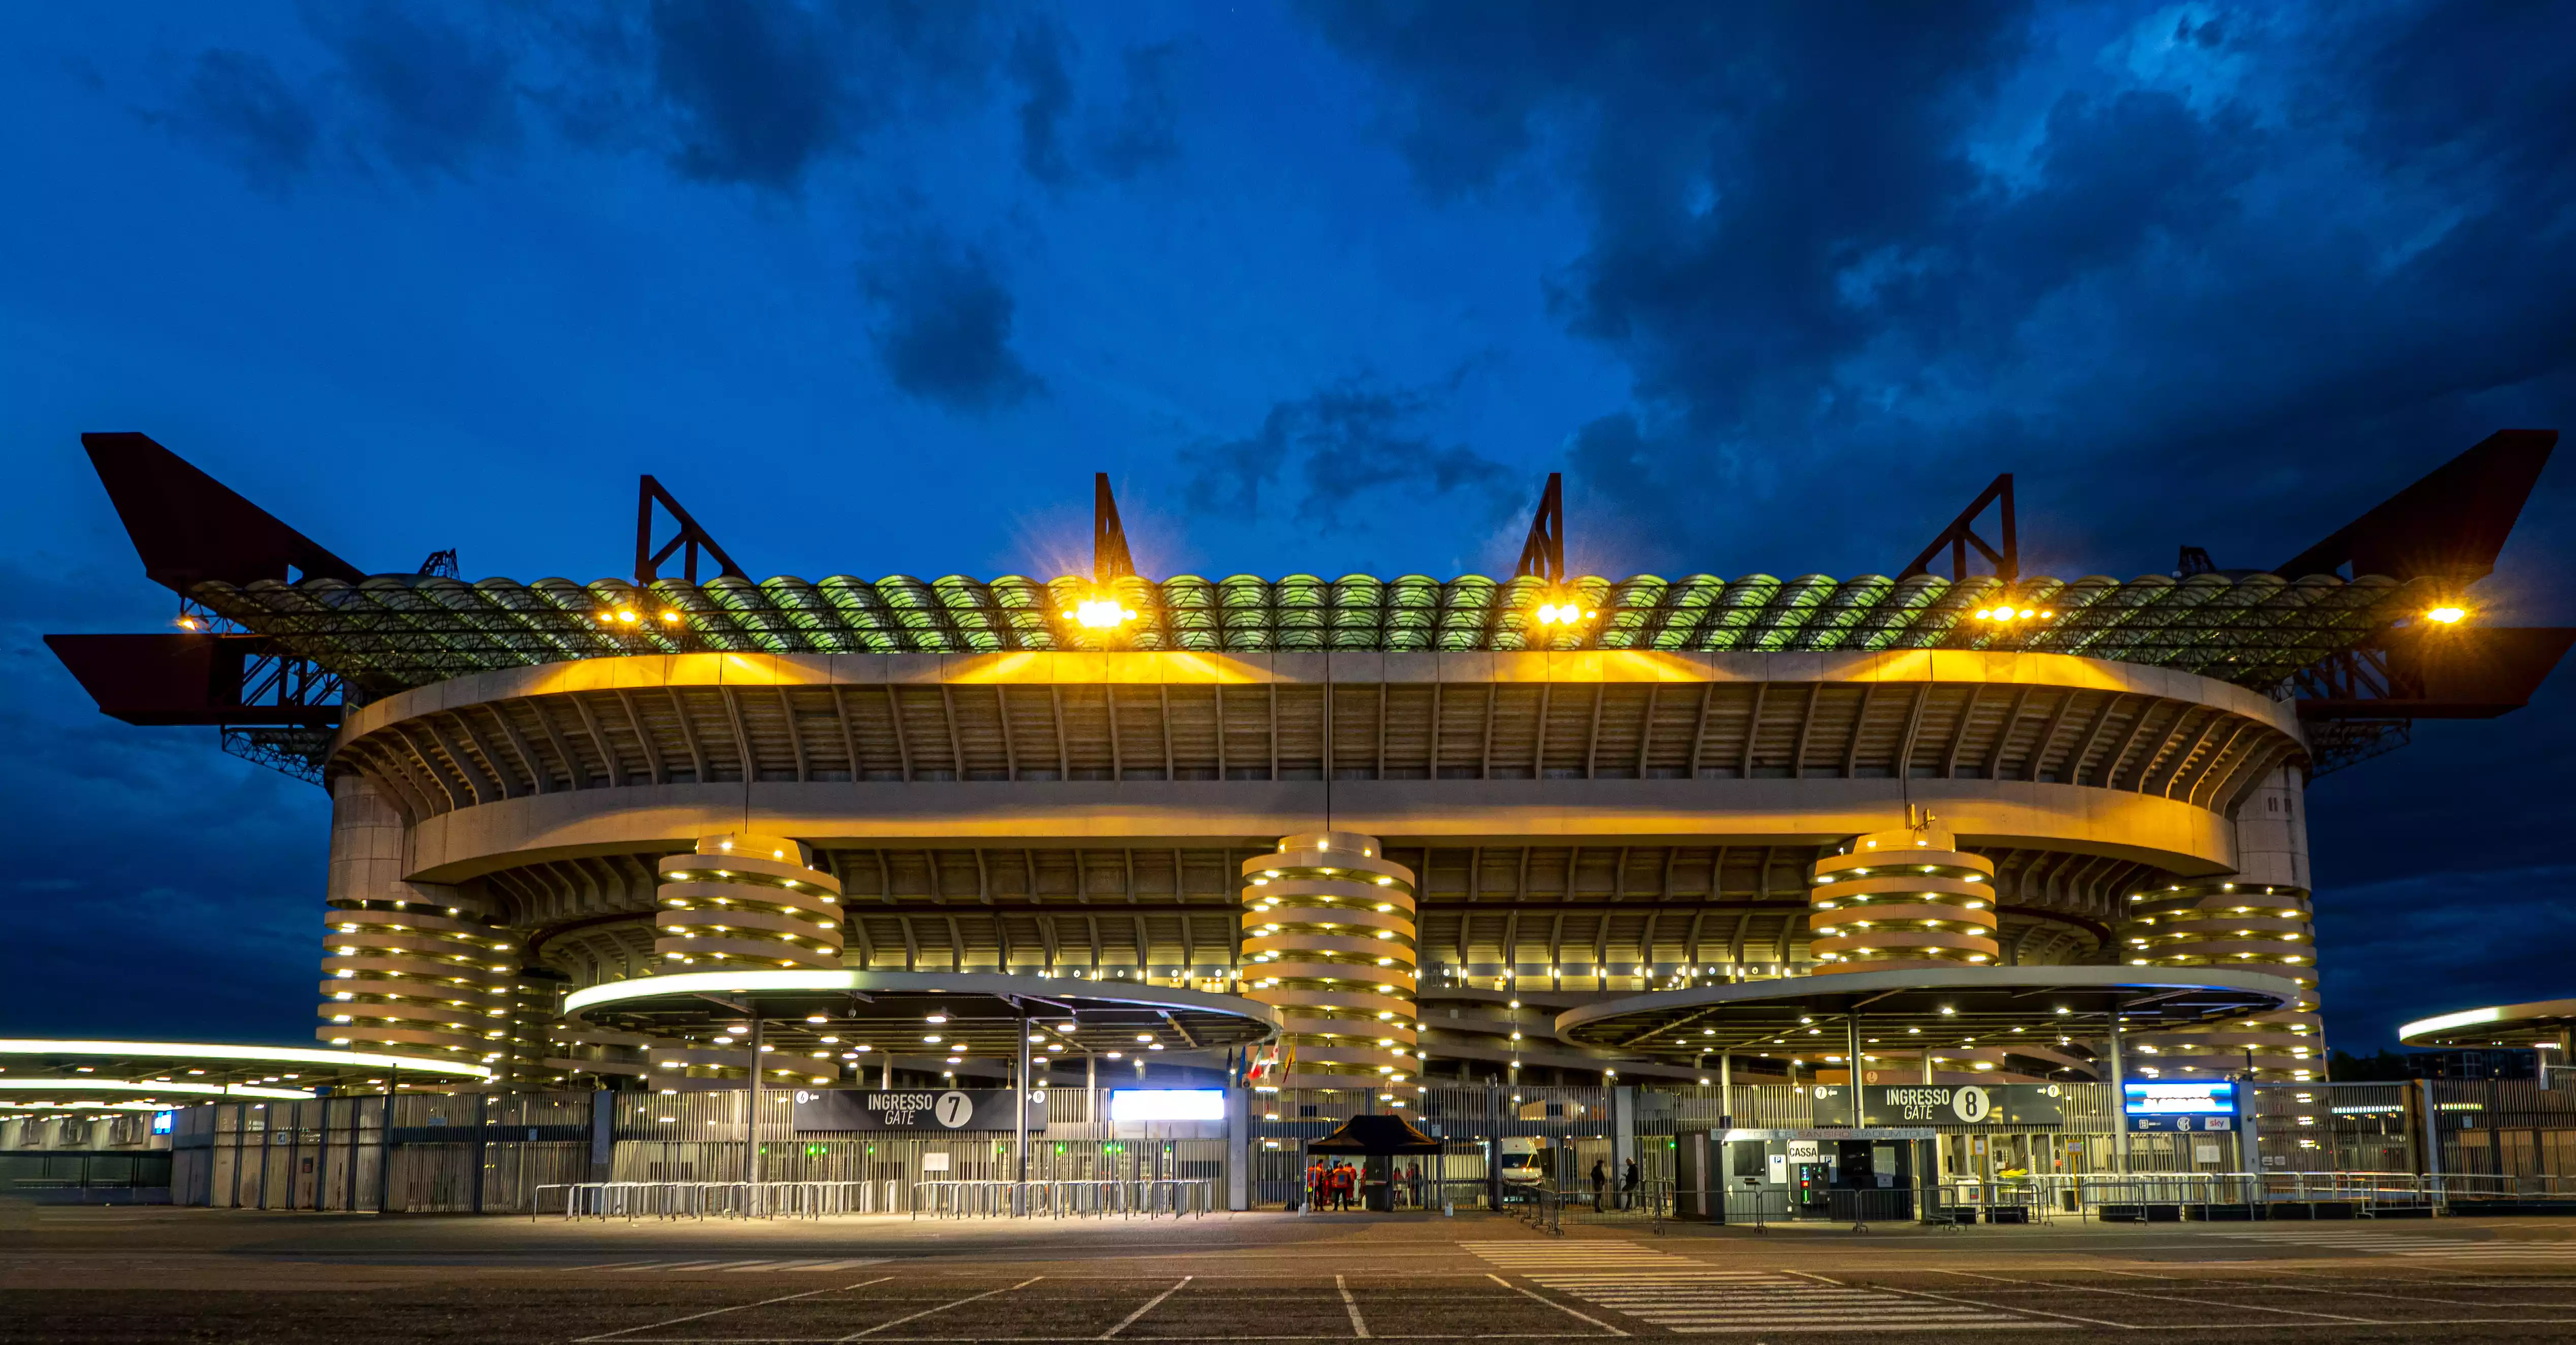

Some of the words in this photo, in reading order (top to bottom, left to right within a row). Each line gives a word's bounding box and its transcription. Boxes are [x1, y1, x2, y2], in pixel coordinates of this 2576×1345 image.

[1819, 1089, 1823, 1097] 7
[2051, 1087, 2056, 1096] 9
[801, 1093, 804, 1101] 6
[868, 1094, 933, 1110] INGRESSO
[948, 1096, 961, 1123] 7
[1886, 1089, 1950, 1105] INGRESSO
[1965, 1091, 1978, 1118] 8
[885, 1110, 916, 1125] GATE
[1904, 1105, 1933, 1120] GATE
[2209, 1119, 2224, 1128] sky
[1789, 1147, 1817, 1157] CASSA
